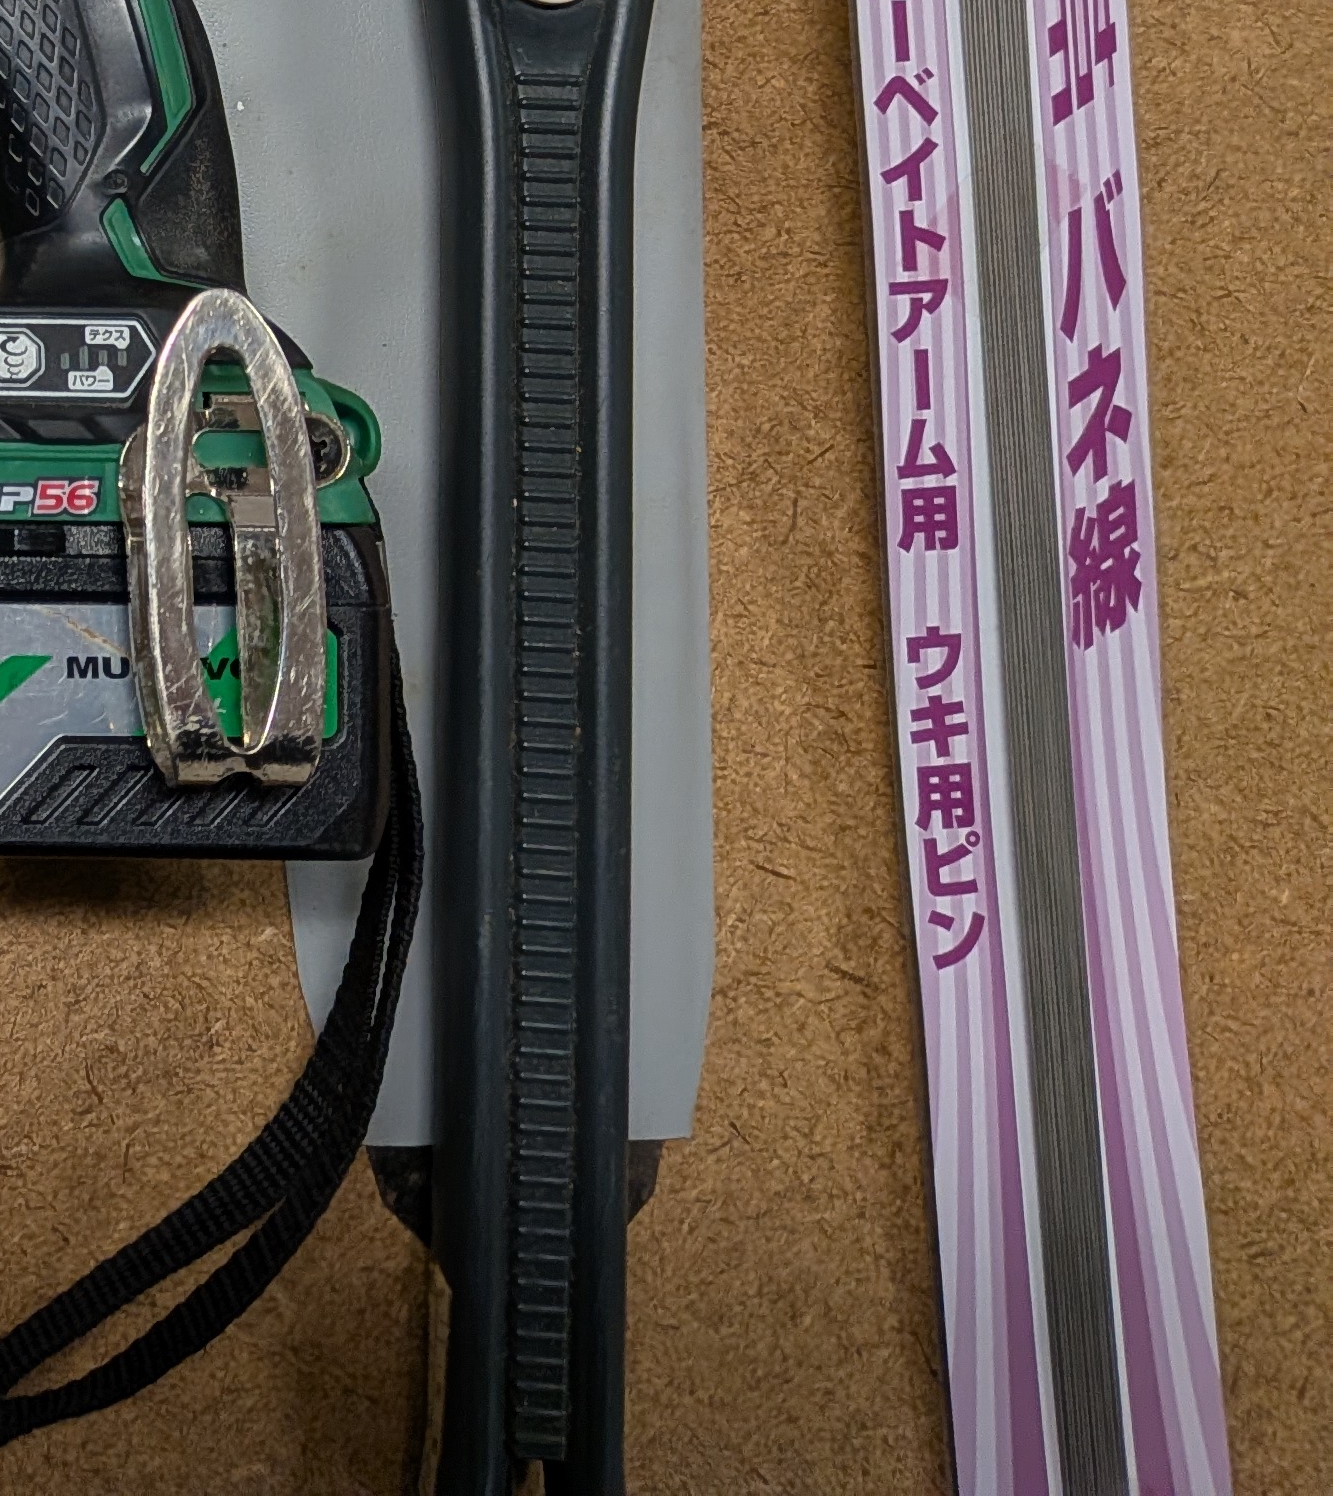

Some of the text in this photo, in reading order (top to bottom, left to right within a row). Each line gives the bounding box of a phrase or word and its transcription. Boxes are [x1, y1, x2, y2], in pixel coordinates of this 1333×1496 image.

[89, 328, 127, 343] テクス
[72, 373, 111, 388] パワー
[905, 625, 987, 971] ウキ用ピン
